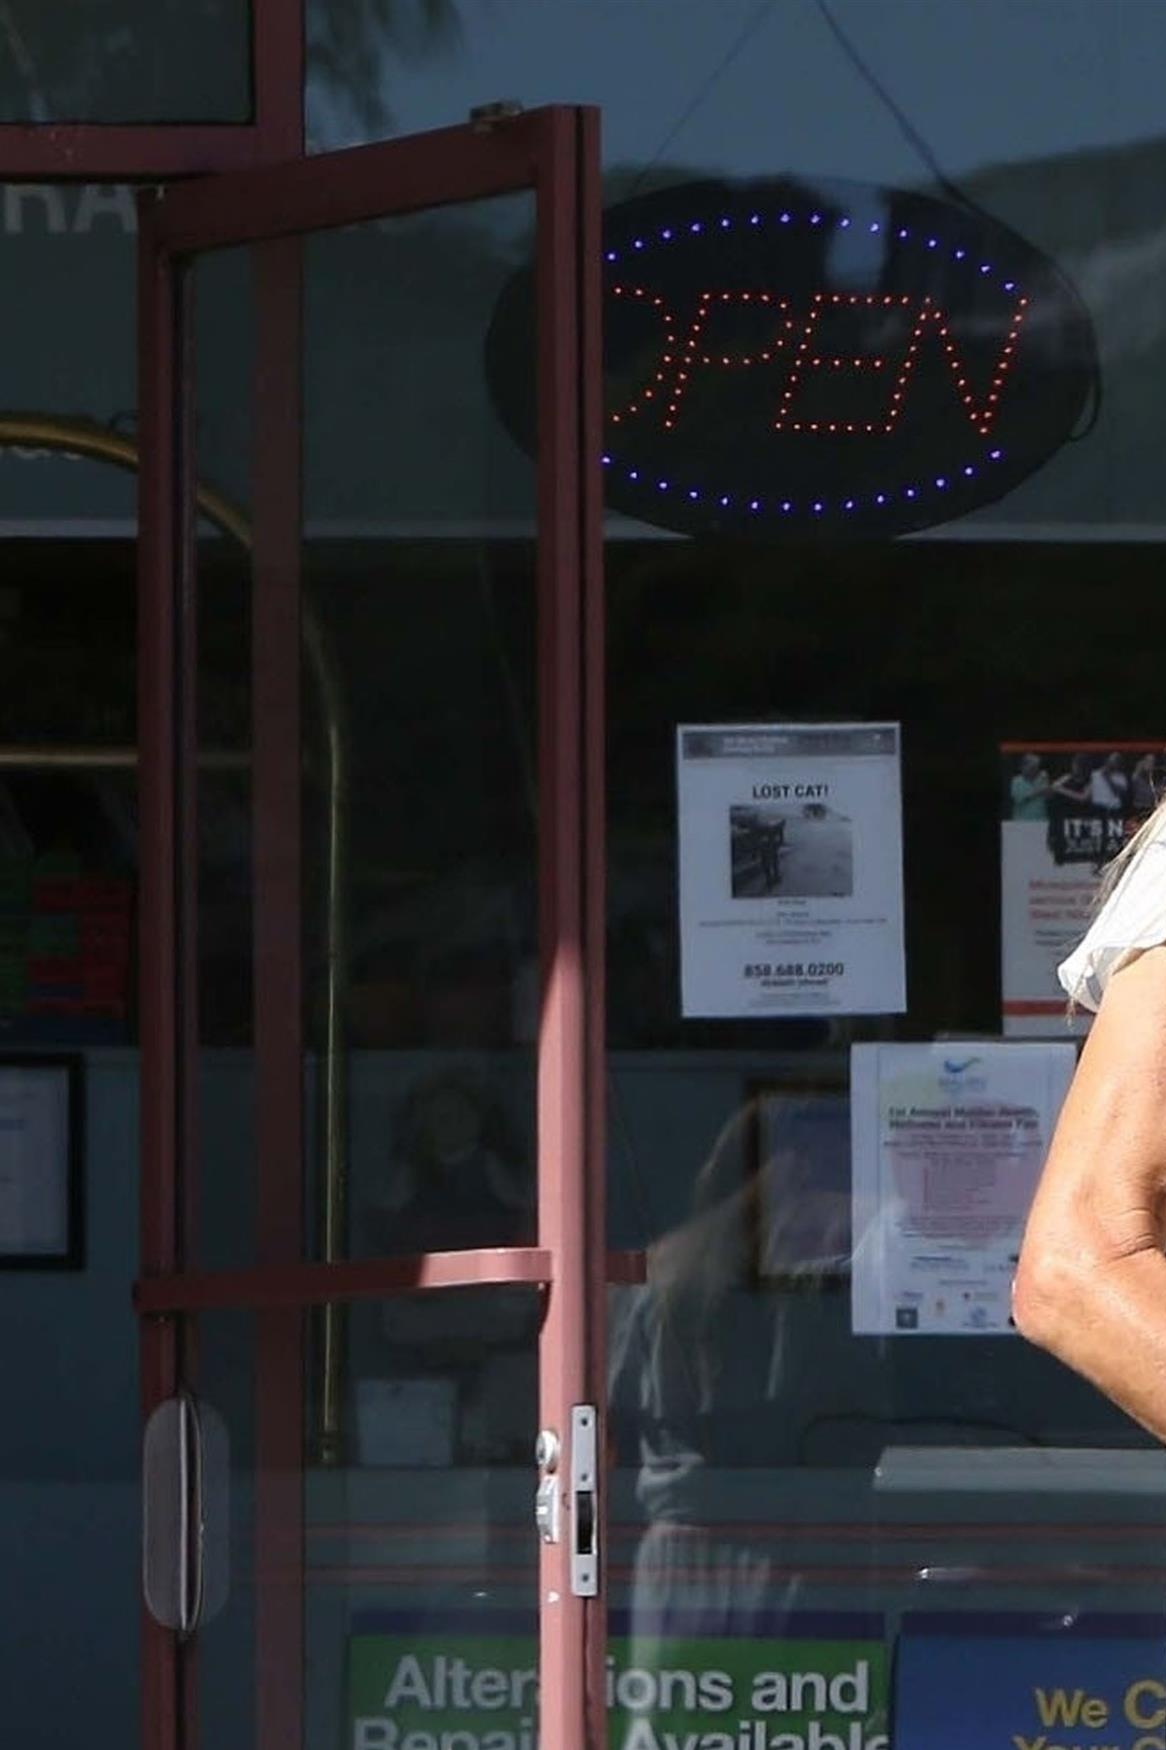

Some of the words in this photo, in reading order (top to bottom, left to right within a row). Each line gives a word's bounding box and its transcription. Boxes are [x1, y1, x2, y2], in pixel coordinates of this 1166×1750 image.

[752, 785, 790, 799] LOST
[795, 784, 829, 798] CAT!
[386, 1655, 733, 1711] Alterions
[752, 1660, 868, 1711] and
[1035, 1687, 1109, 1728] We
